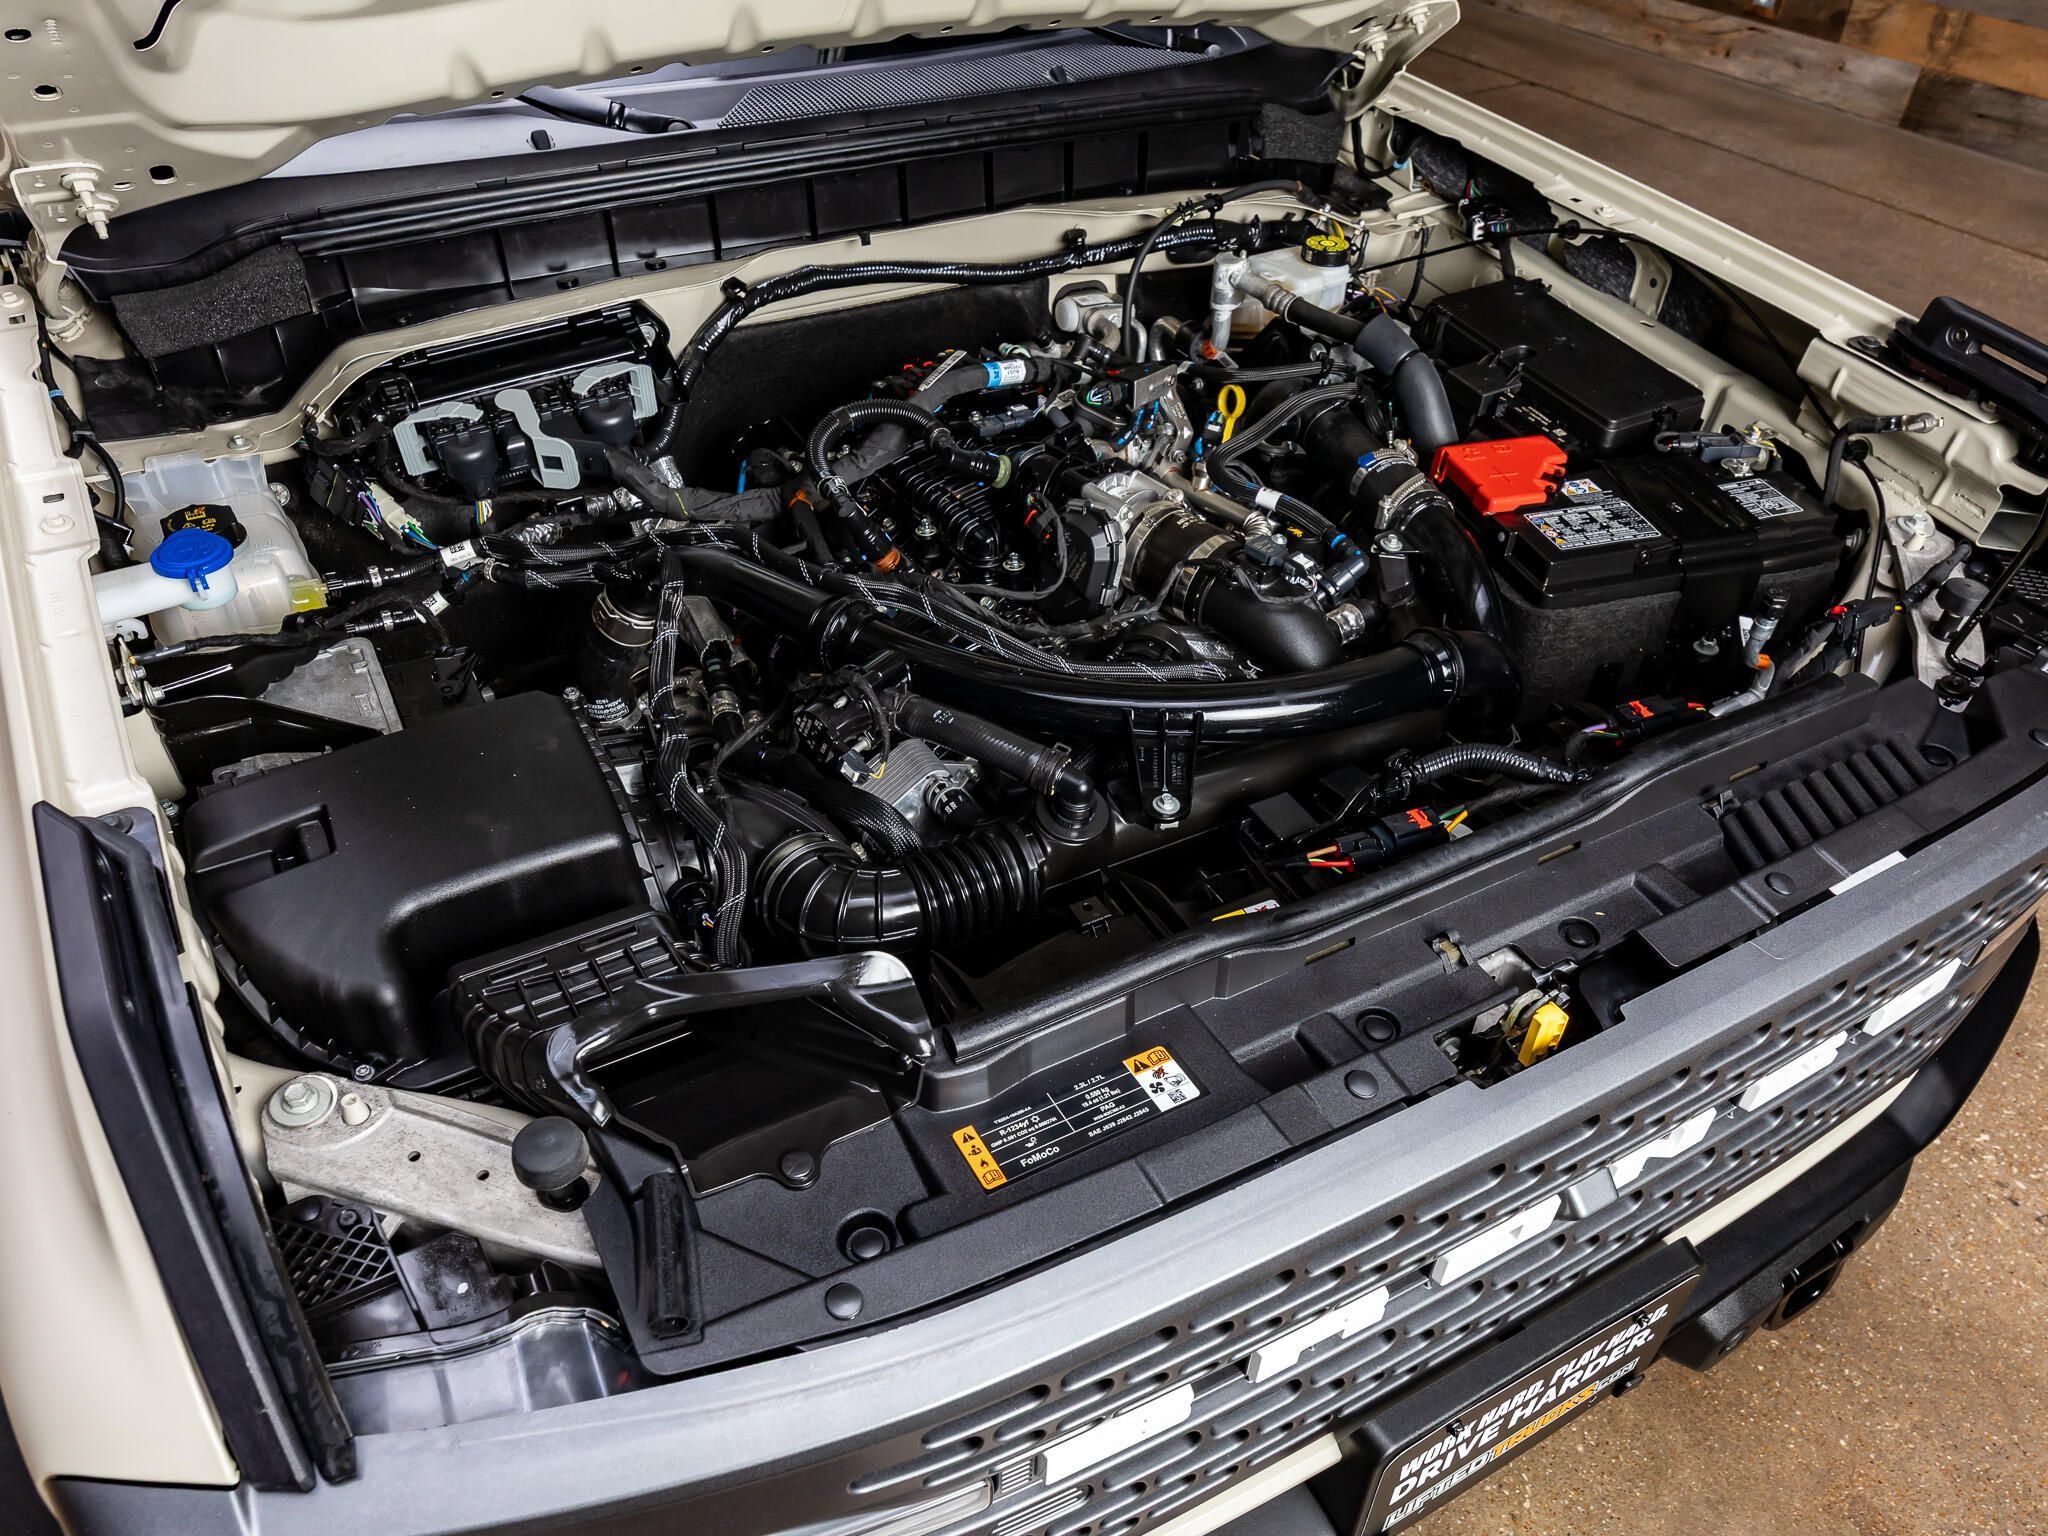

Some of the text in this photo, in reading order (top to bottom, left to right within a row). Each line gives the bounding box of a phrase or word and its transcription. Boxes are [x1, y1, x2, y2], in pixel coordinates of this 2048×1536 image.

[1073, 1081, 1088, 1091] 2.3L
[1090, 1074, 1105, 1083] 2.7L
[1085, 1086, 1110, 1100] 0.550 kg
[1099, 1101, 1116, 1112] PAG
[999, 1116, 1030, 1136] R-1234yf
[1017, 1128, 1029, 1137] CO2
[1088, 1127, 1103, 1138] SAE
[1102, 1121, 1117, 1132] J639
[1020, 1146, 1060, 1167] FoMoCo
[1476, 1379, 1545, 1432] HARD.
[1548, 1340, 1608, 1387] PLAY
[1388, 1328, 1655, 1506] DRIVE HARDER.
